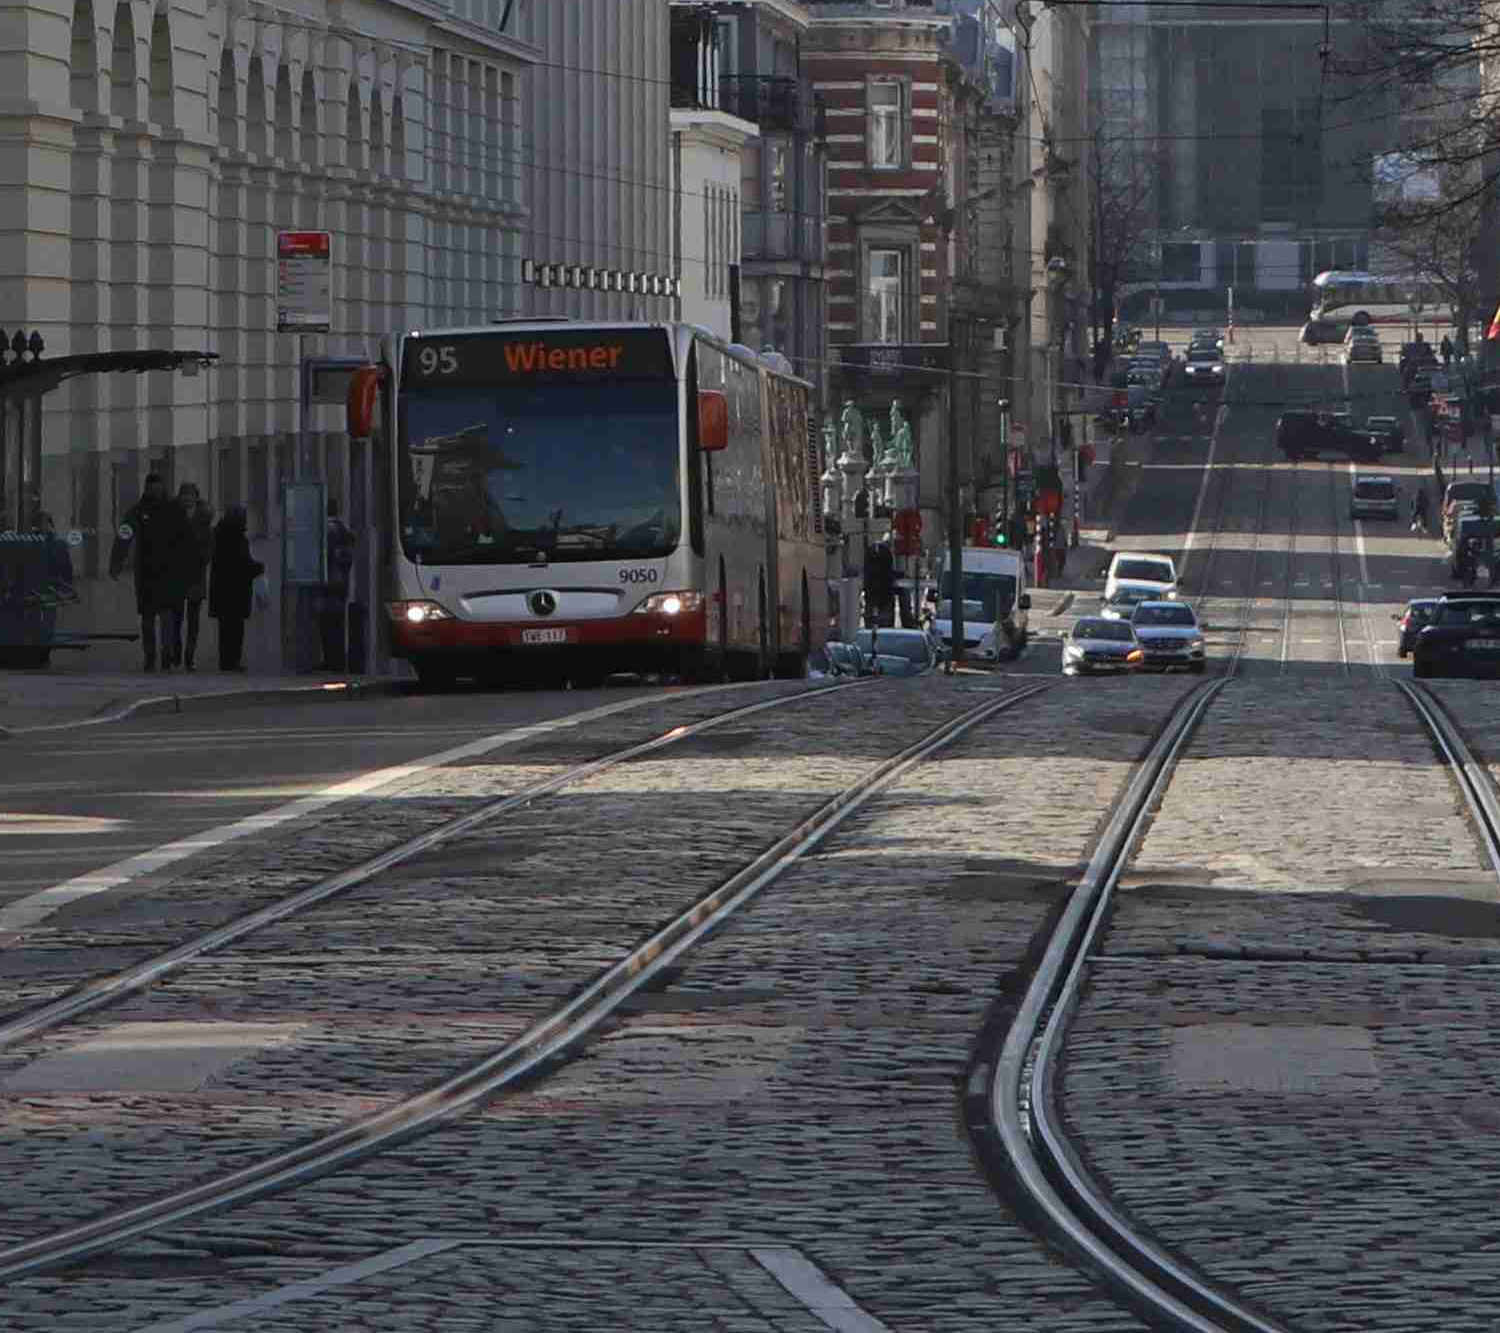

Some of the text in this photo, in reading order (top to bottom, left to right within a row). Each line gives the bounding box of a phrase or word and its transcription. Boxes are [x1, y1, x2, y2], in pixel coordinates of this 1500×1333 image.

[419, 346, 458, 375] 95
[504, 341, 623, 373] Wiener
[619, 568, 657, 583] 9050
